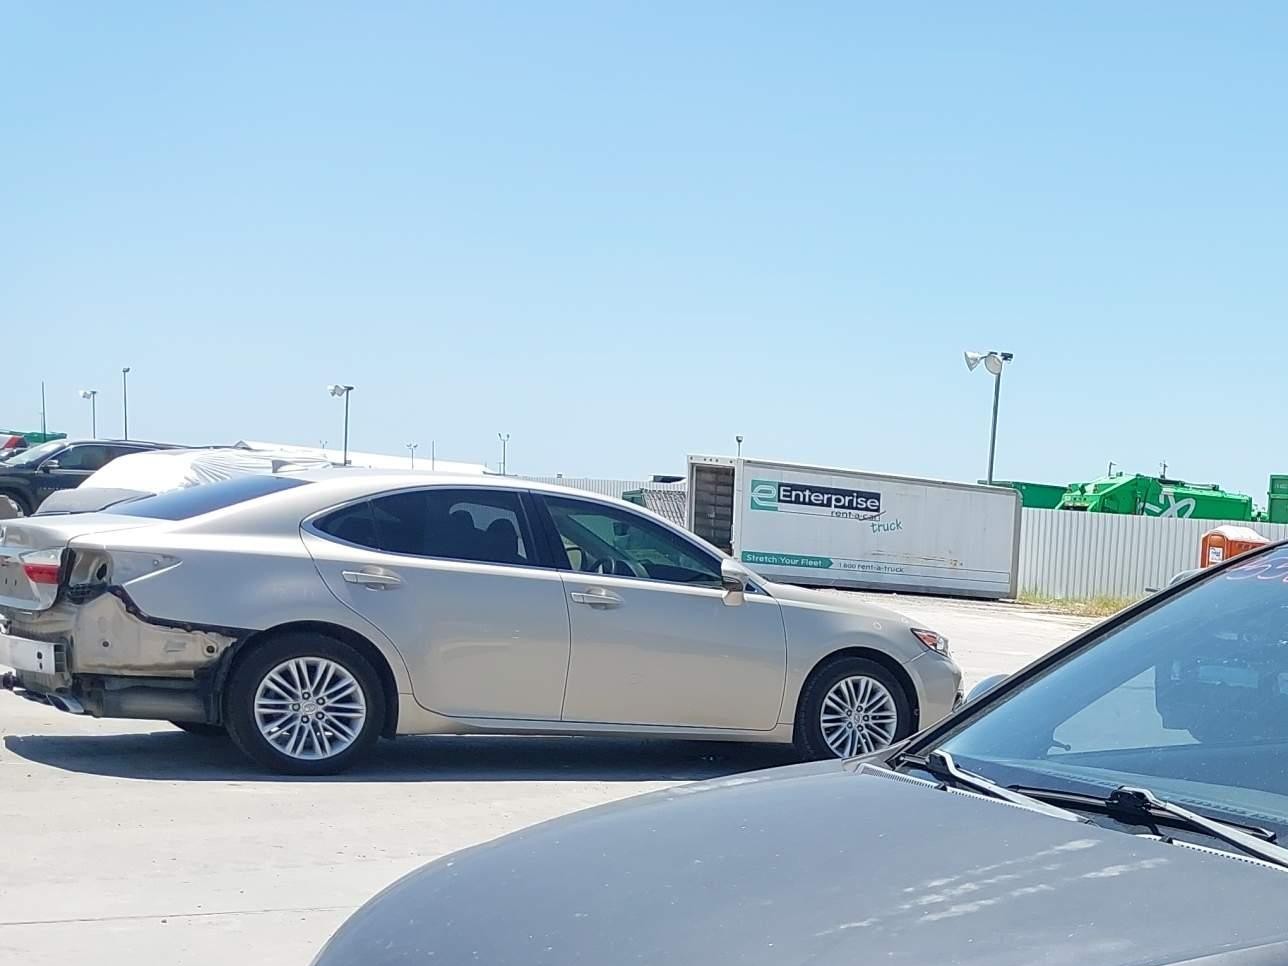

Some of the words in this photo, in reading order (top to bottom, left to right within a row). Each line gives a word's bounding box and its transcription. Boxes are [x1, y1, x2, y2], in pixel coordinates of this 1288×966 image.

[780, 486, 880, 510] Enterprise
[871, 519, 903, 533] truck
[746, 554, 778, 564] Stretch
[780, 556, 799, 565] Your
[801, 558, 822, 567] Fleet
